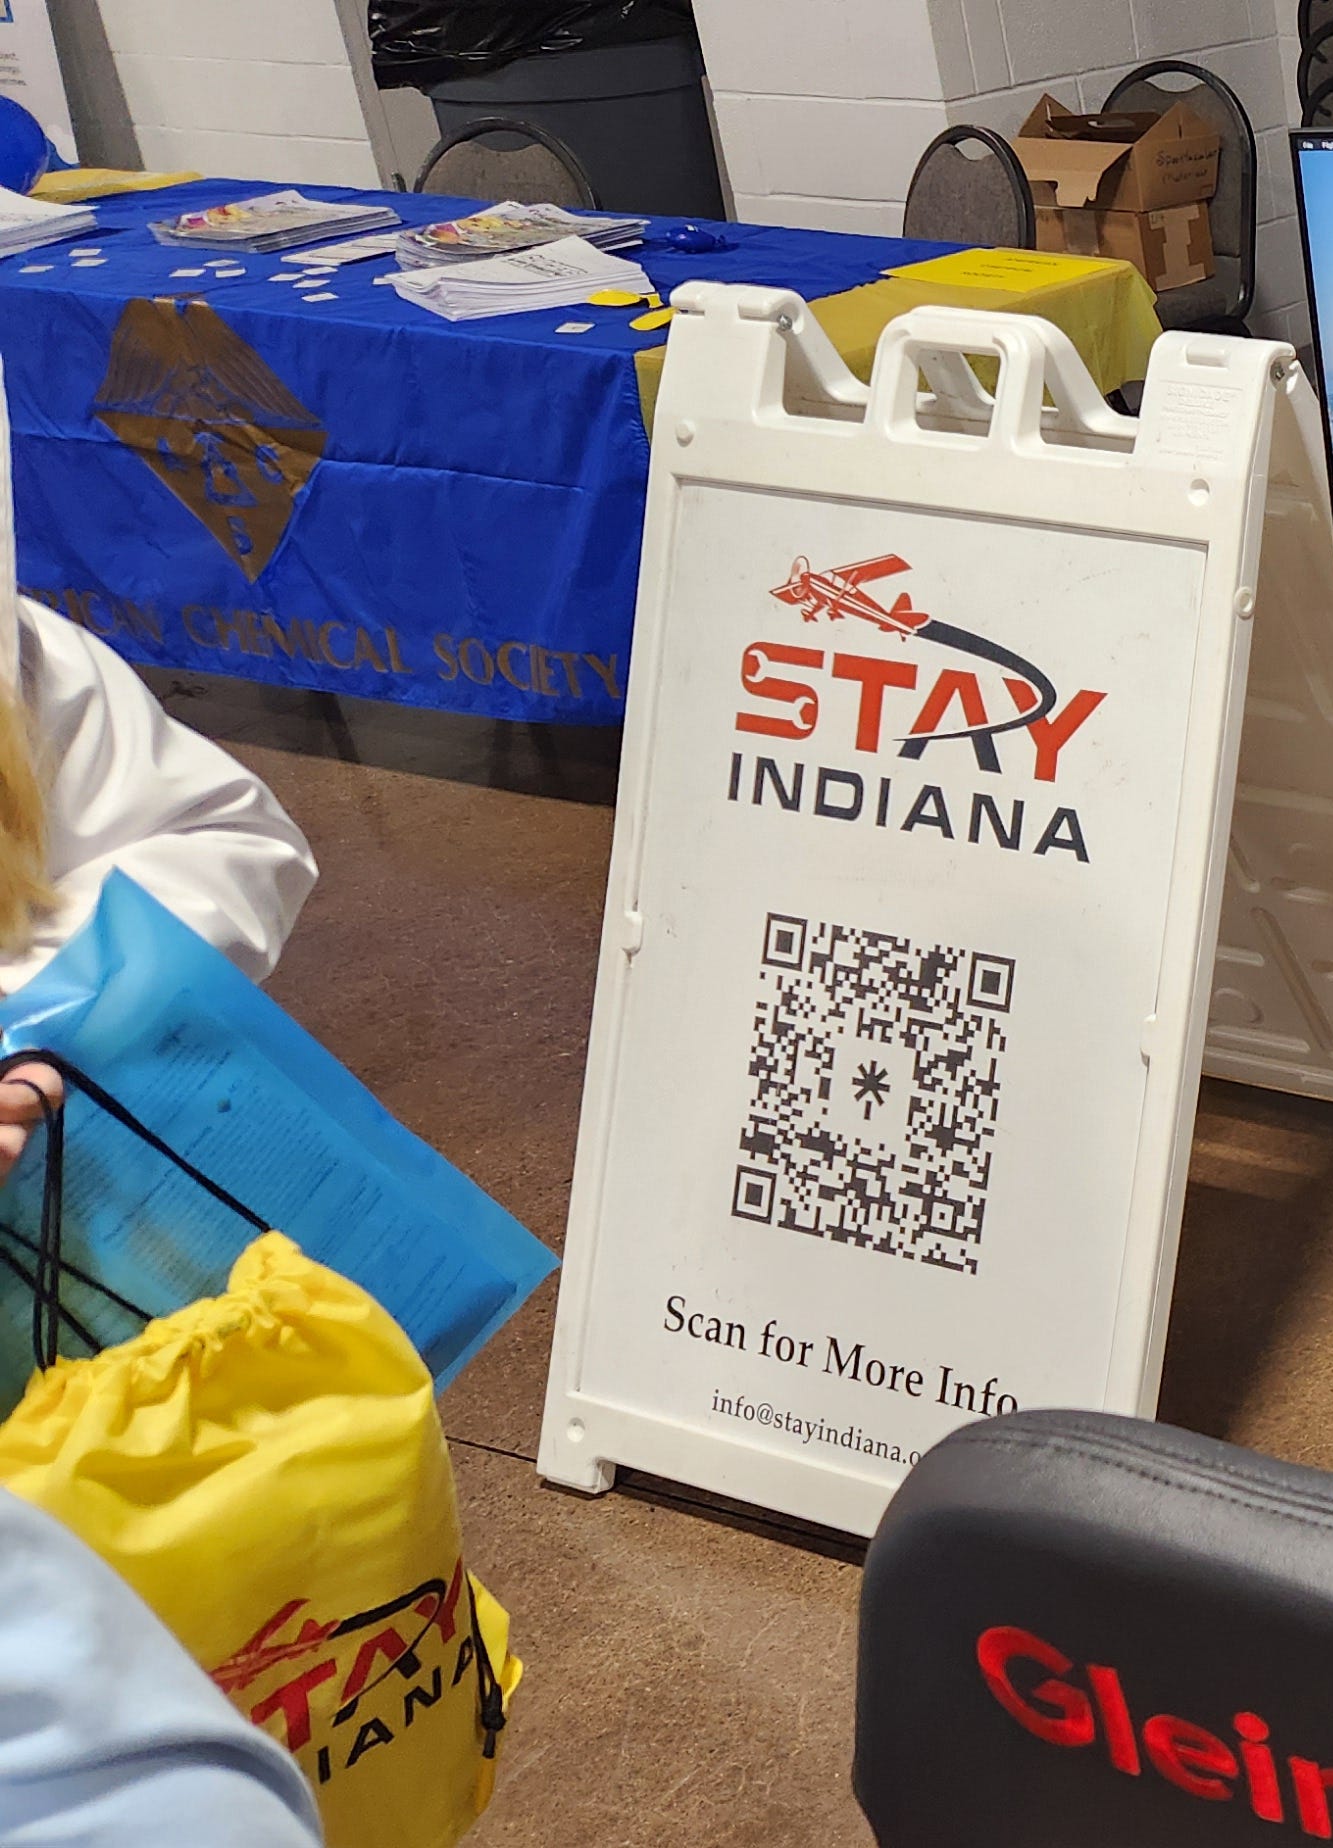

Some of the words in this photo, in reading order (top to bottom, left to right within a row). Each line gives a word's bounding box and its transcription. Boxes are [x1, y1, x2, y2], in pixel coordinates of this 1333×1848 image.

[181, 603, 413, 675] CHEMICAL
[433, 632, 622, 700] SOCIETY
[735, 640, 1109, 783] STAY
[727, 751, 1091, 865] INDIANA
[663, 1294, 748, 1351] Scan
[757, 1318, 815, 1368] for
[822, 1334, 925, 1398] More
[934, 1364, 1020, 1418] Info
[710, 1388, 922, 1468] info@stayindiana.o
[250, 1556, 465, 1755] TAY
[317, 1634, 474, 1784] IANA
